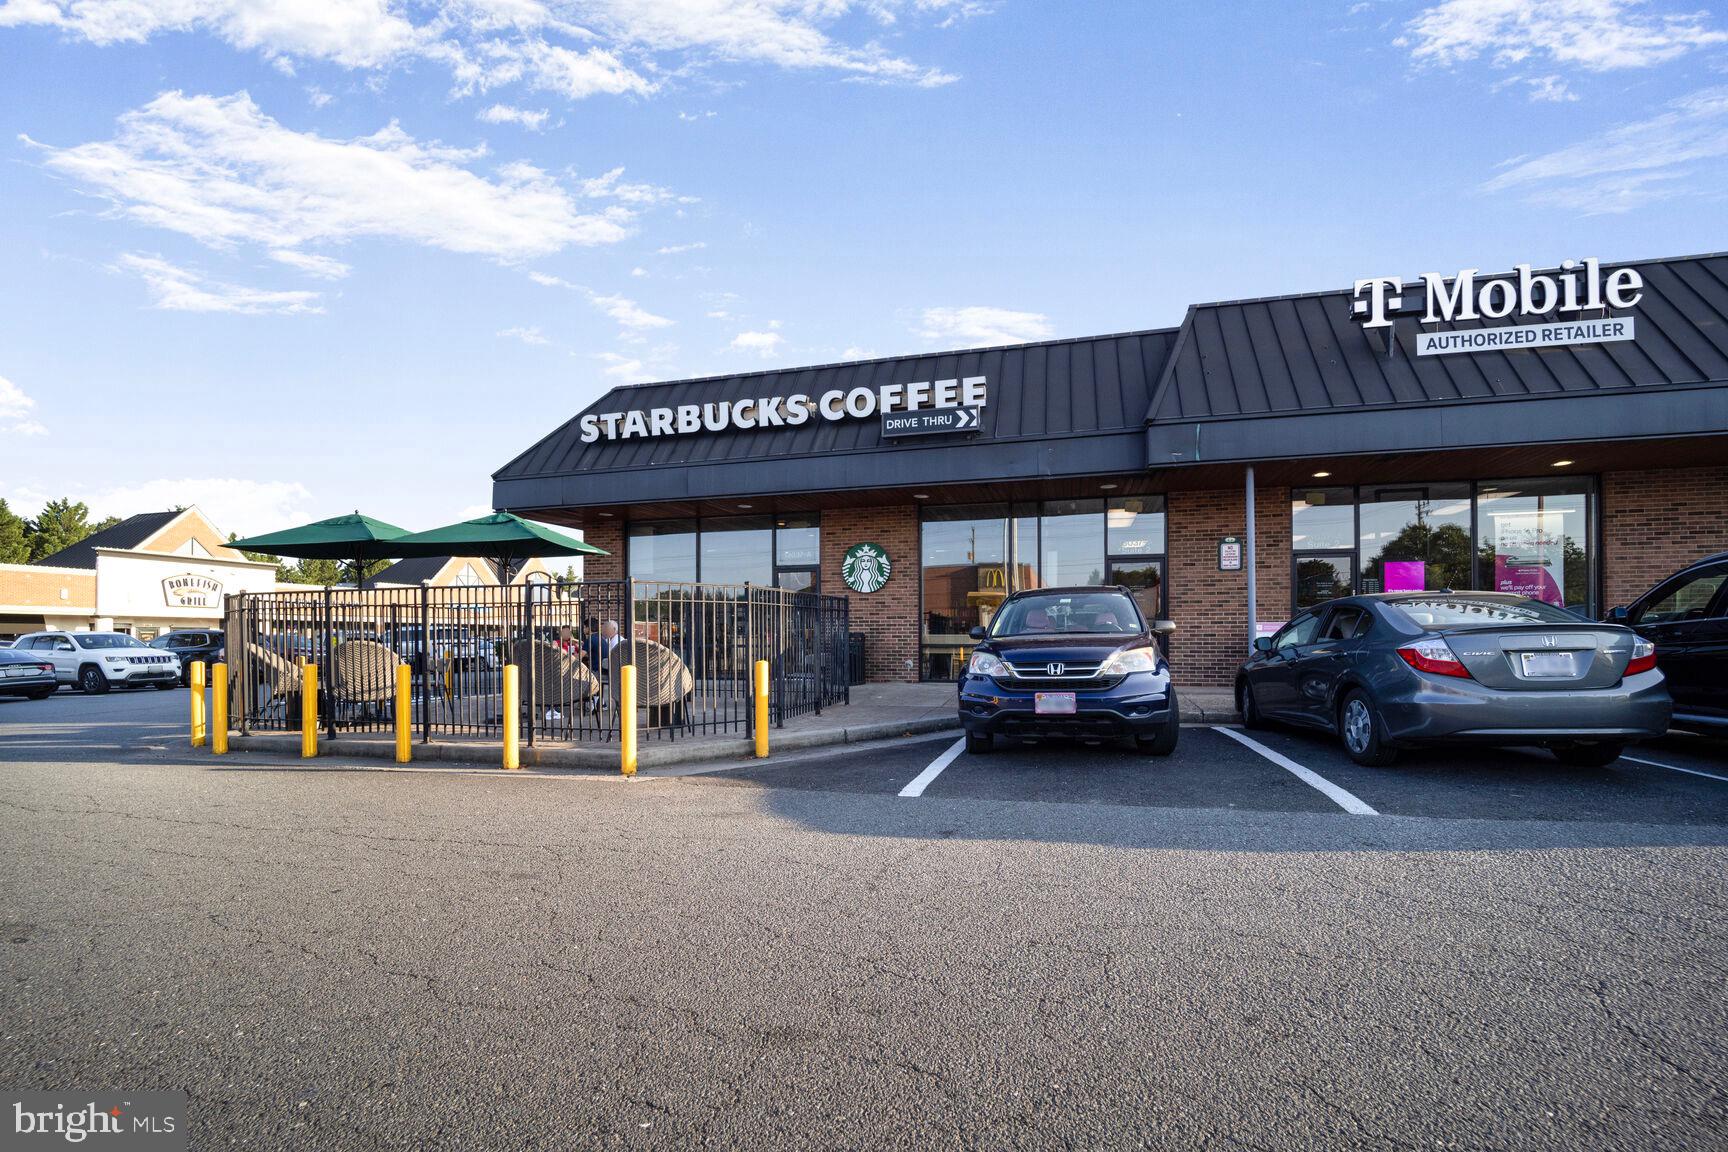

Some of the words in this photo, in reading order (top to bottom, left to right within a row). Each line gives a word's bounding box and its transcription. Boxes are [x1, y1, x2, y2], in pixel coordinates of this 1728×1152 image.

[1419, 256, 1644, 324] Mobile
[1426, 329, 1537, 351] AUTHORIZED
[1541, 322, 1625, 342] RETAILER
[580, 394, 810, 443] STARBUCKS
[819, 375, 987, 421] COFFEE
[886, 417, 918, 430] DRIVE
[922, 414, 953, 427] THRU
[168, 578, 219, 592] BONEFISH
[180, 597, 206, 606] GRILL
